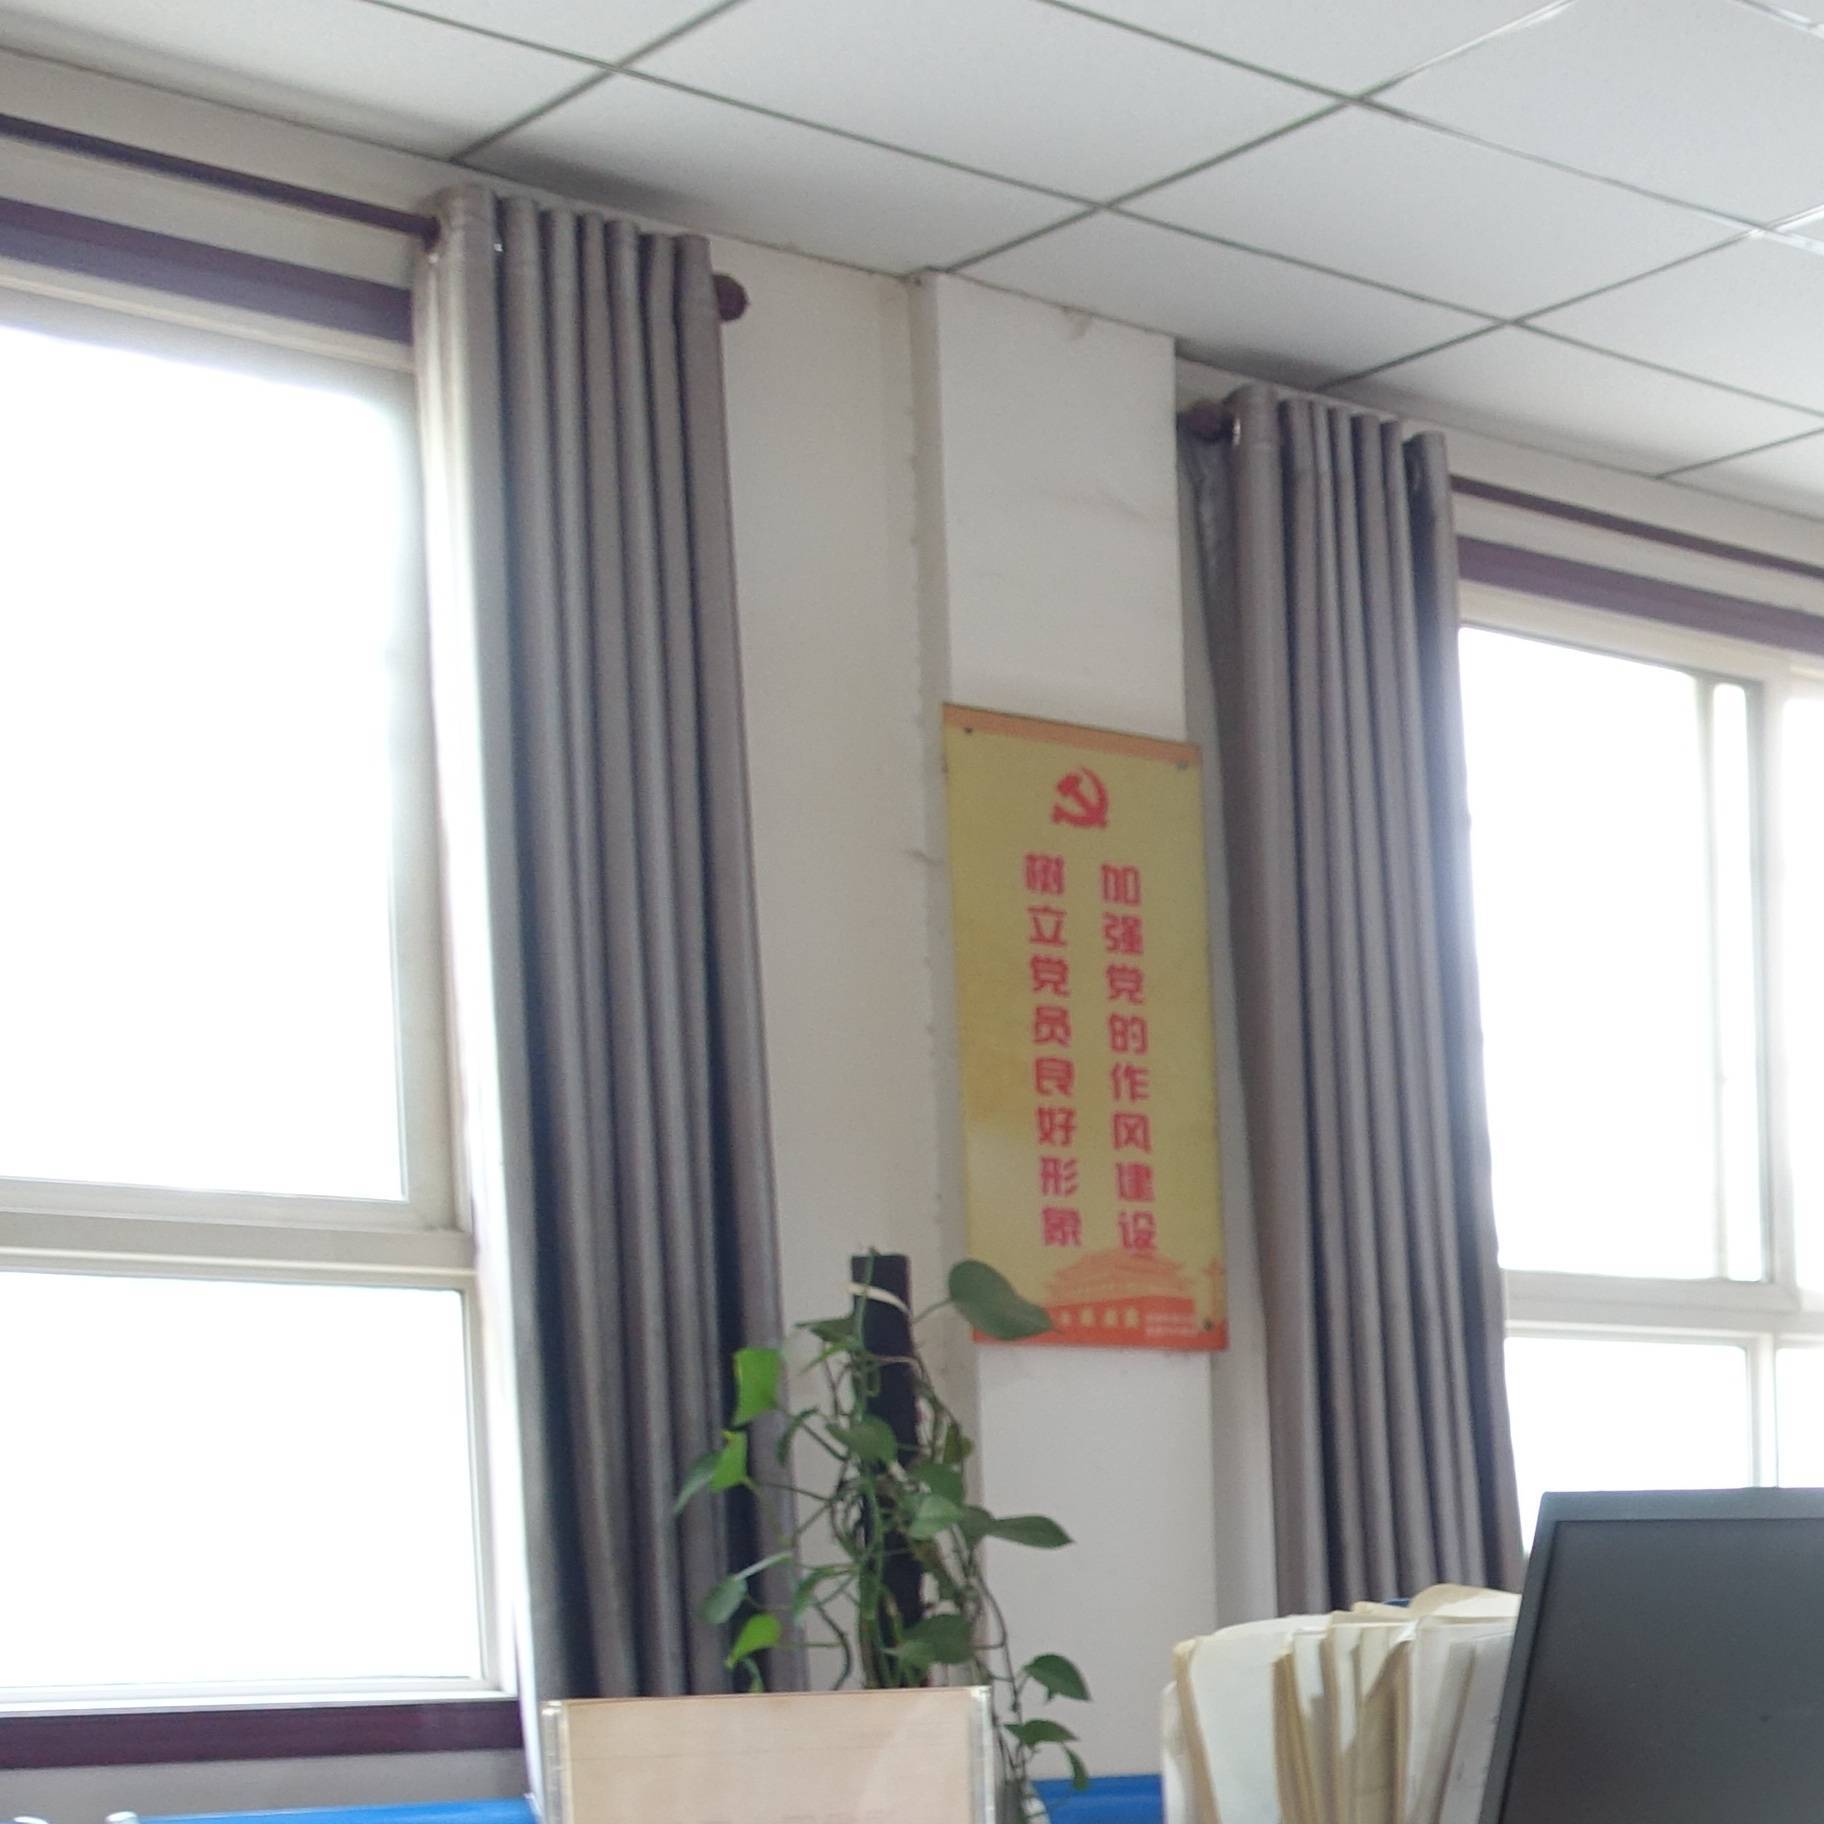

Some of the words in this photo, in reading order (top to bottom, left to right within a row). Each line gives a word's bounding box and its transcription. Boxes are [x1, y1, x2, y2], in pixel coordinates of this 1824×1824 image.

[1024, 852, 1083, 1248] 树立党员良好形象
[1100, 864, 1158, 1253] 加强党的作风建设
